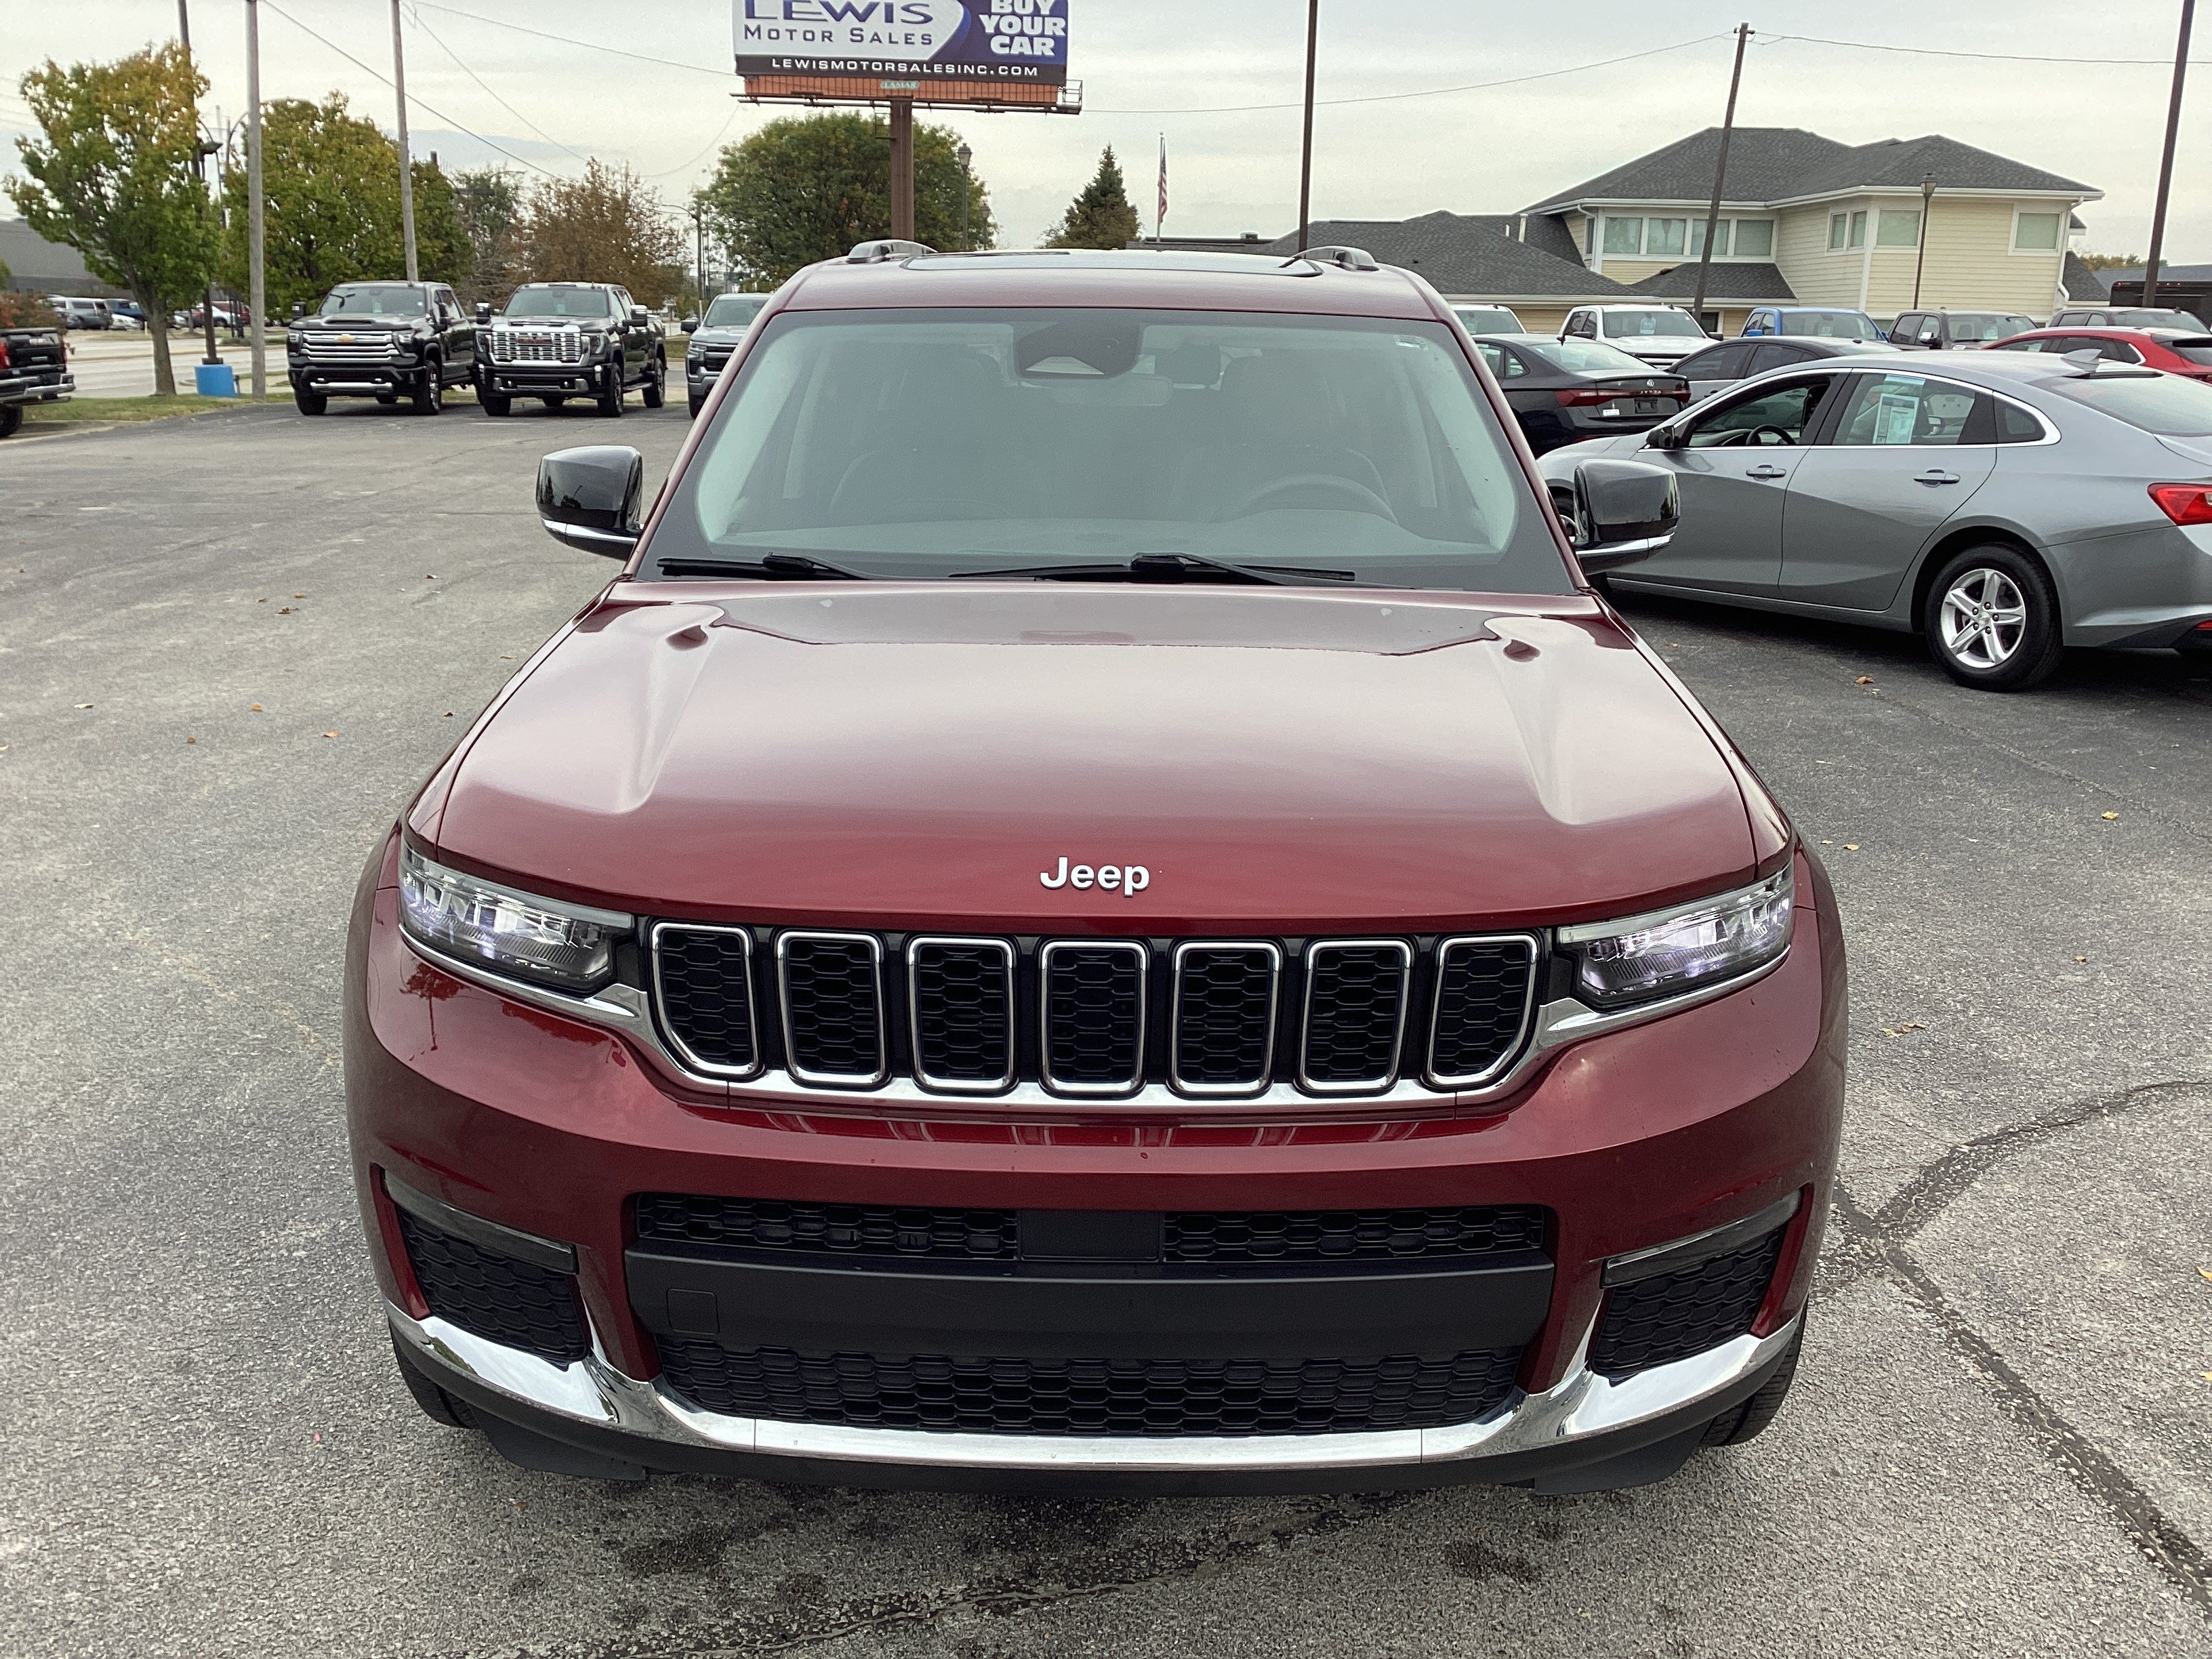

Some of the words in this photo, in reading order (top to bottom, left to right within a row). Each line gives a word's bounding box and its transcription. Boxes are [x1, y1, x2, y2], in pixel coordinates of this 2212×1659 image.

[745, 0, 934, 24] LEWIS
[991, 0, 1055, 15] BUY
[743, 24, 834, 43] MOTOR
[849, 27, 933, 45] SALES
[979, 14, 1065, 36] YOUR
[990, 35, 1054, 56] CAR
[771, 58, 1038, 76] LEWISMOTORSALESINC.COM
[1040, 857, 1150, 898] Jeep
